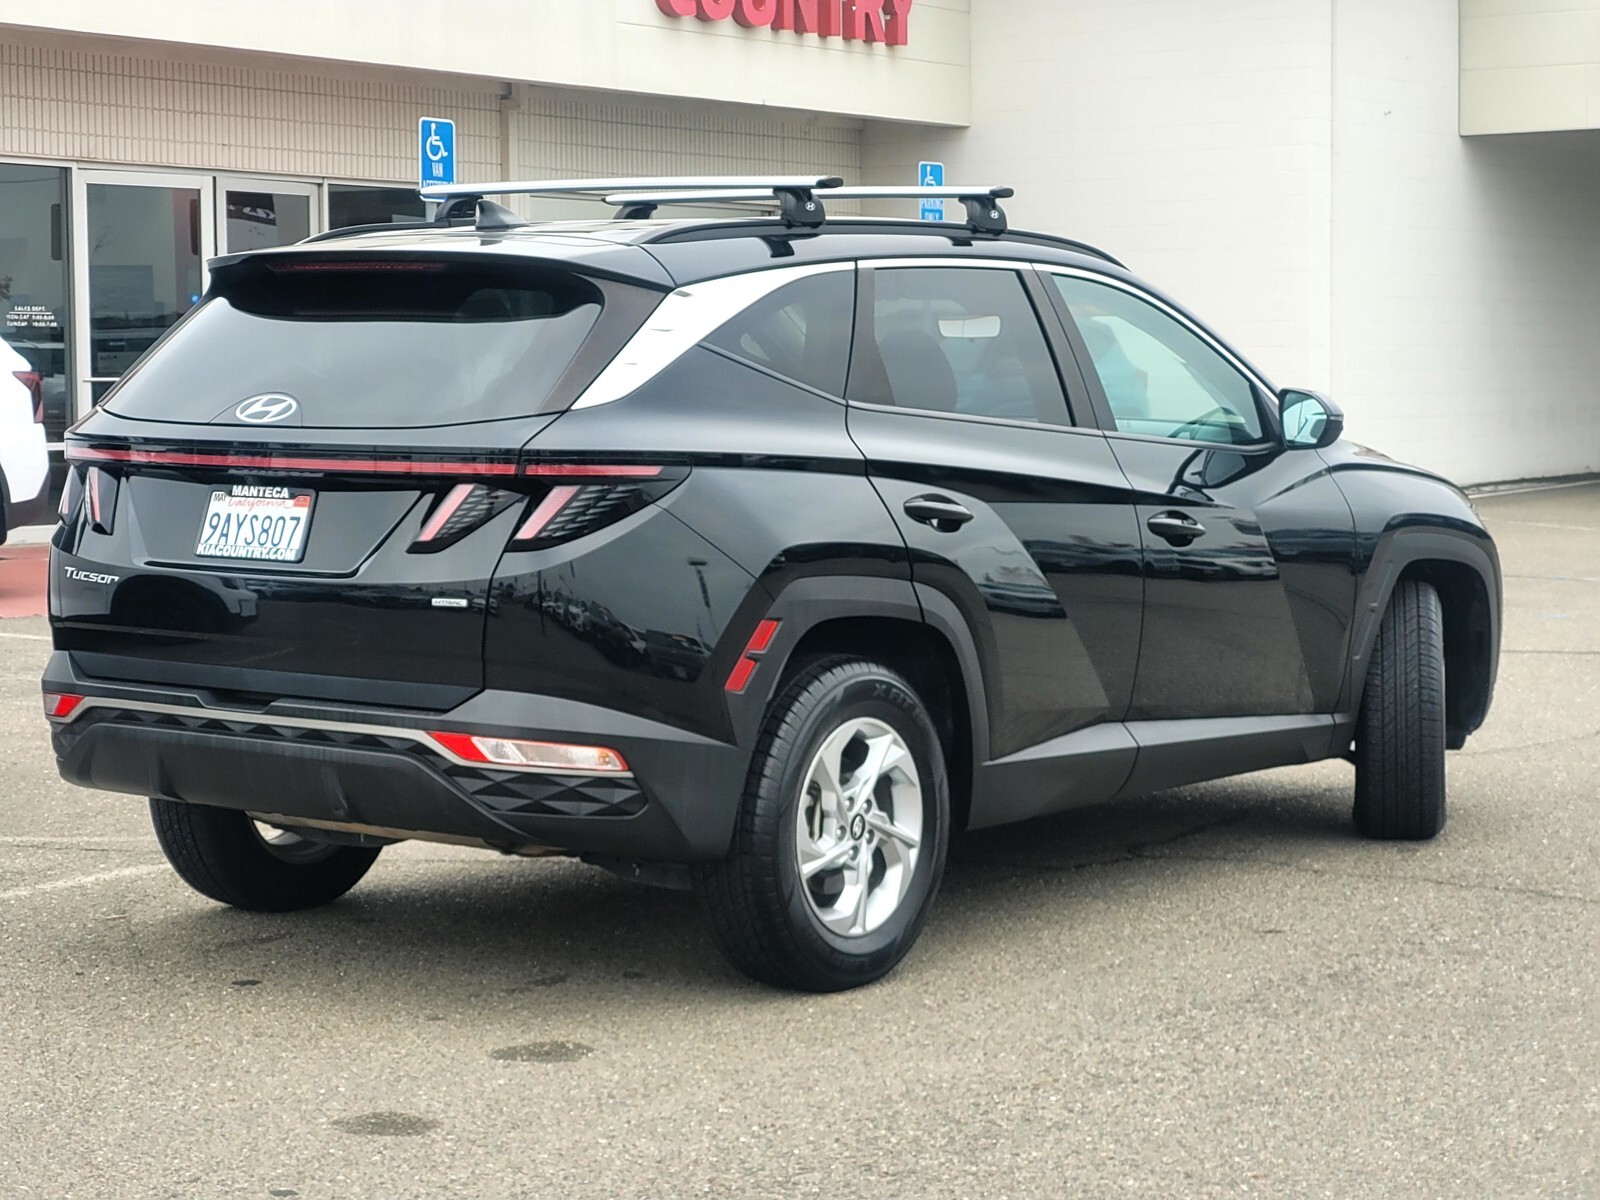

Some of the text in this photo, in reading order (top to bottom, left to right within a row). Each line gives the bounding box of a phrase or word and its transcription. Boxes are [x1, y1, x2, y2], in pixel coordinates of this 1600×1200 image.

[655, 0, 912, 46] NTRY
[431, 162, 444, 178] VAN
[231, 485, 290, 498] MANTECA
[228, 497, 291, 512] California
[203, 512, 301, 549] 9AYS807
[196, 543, 297, 561] KIACOUNTRY.COM
